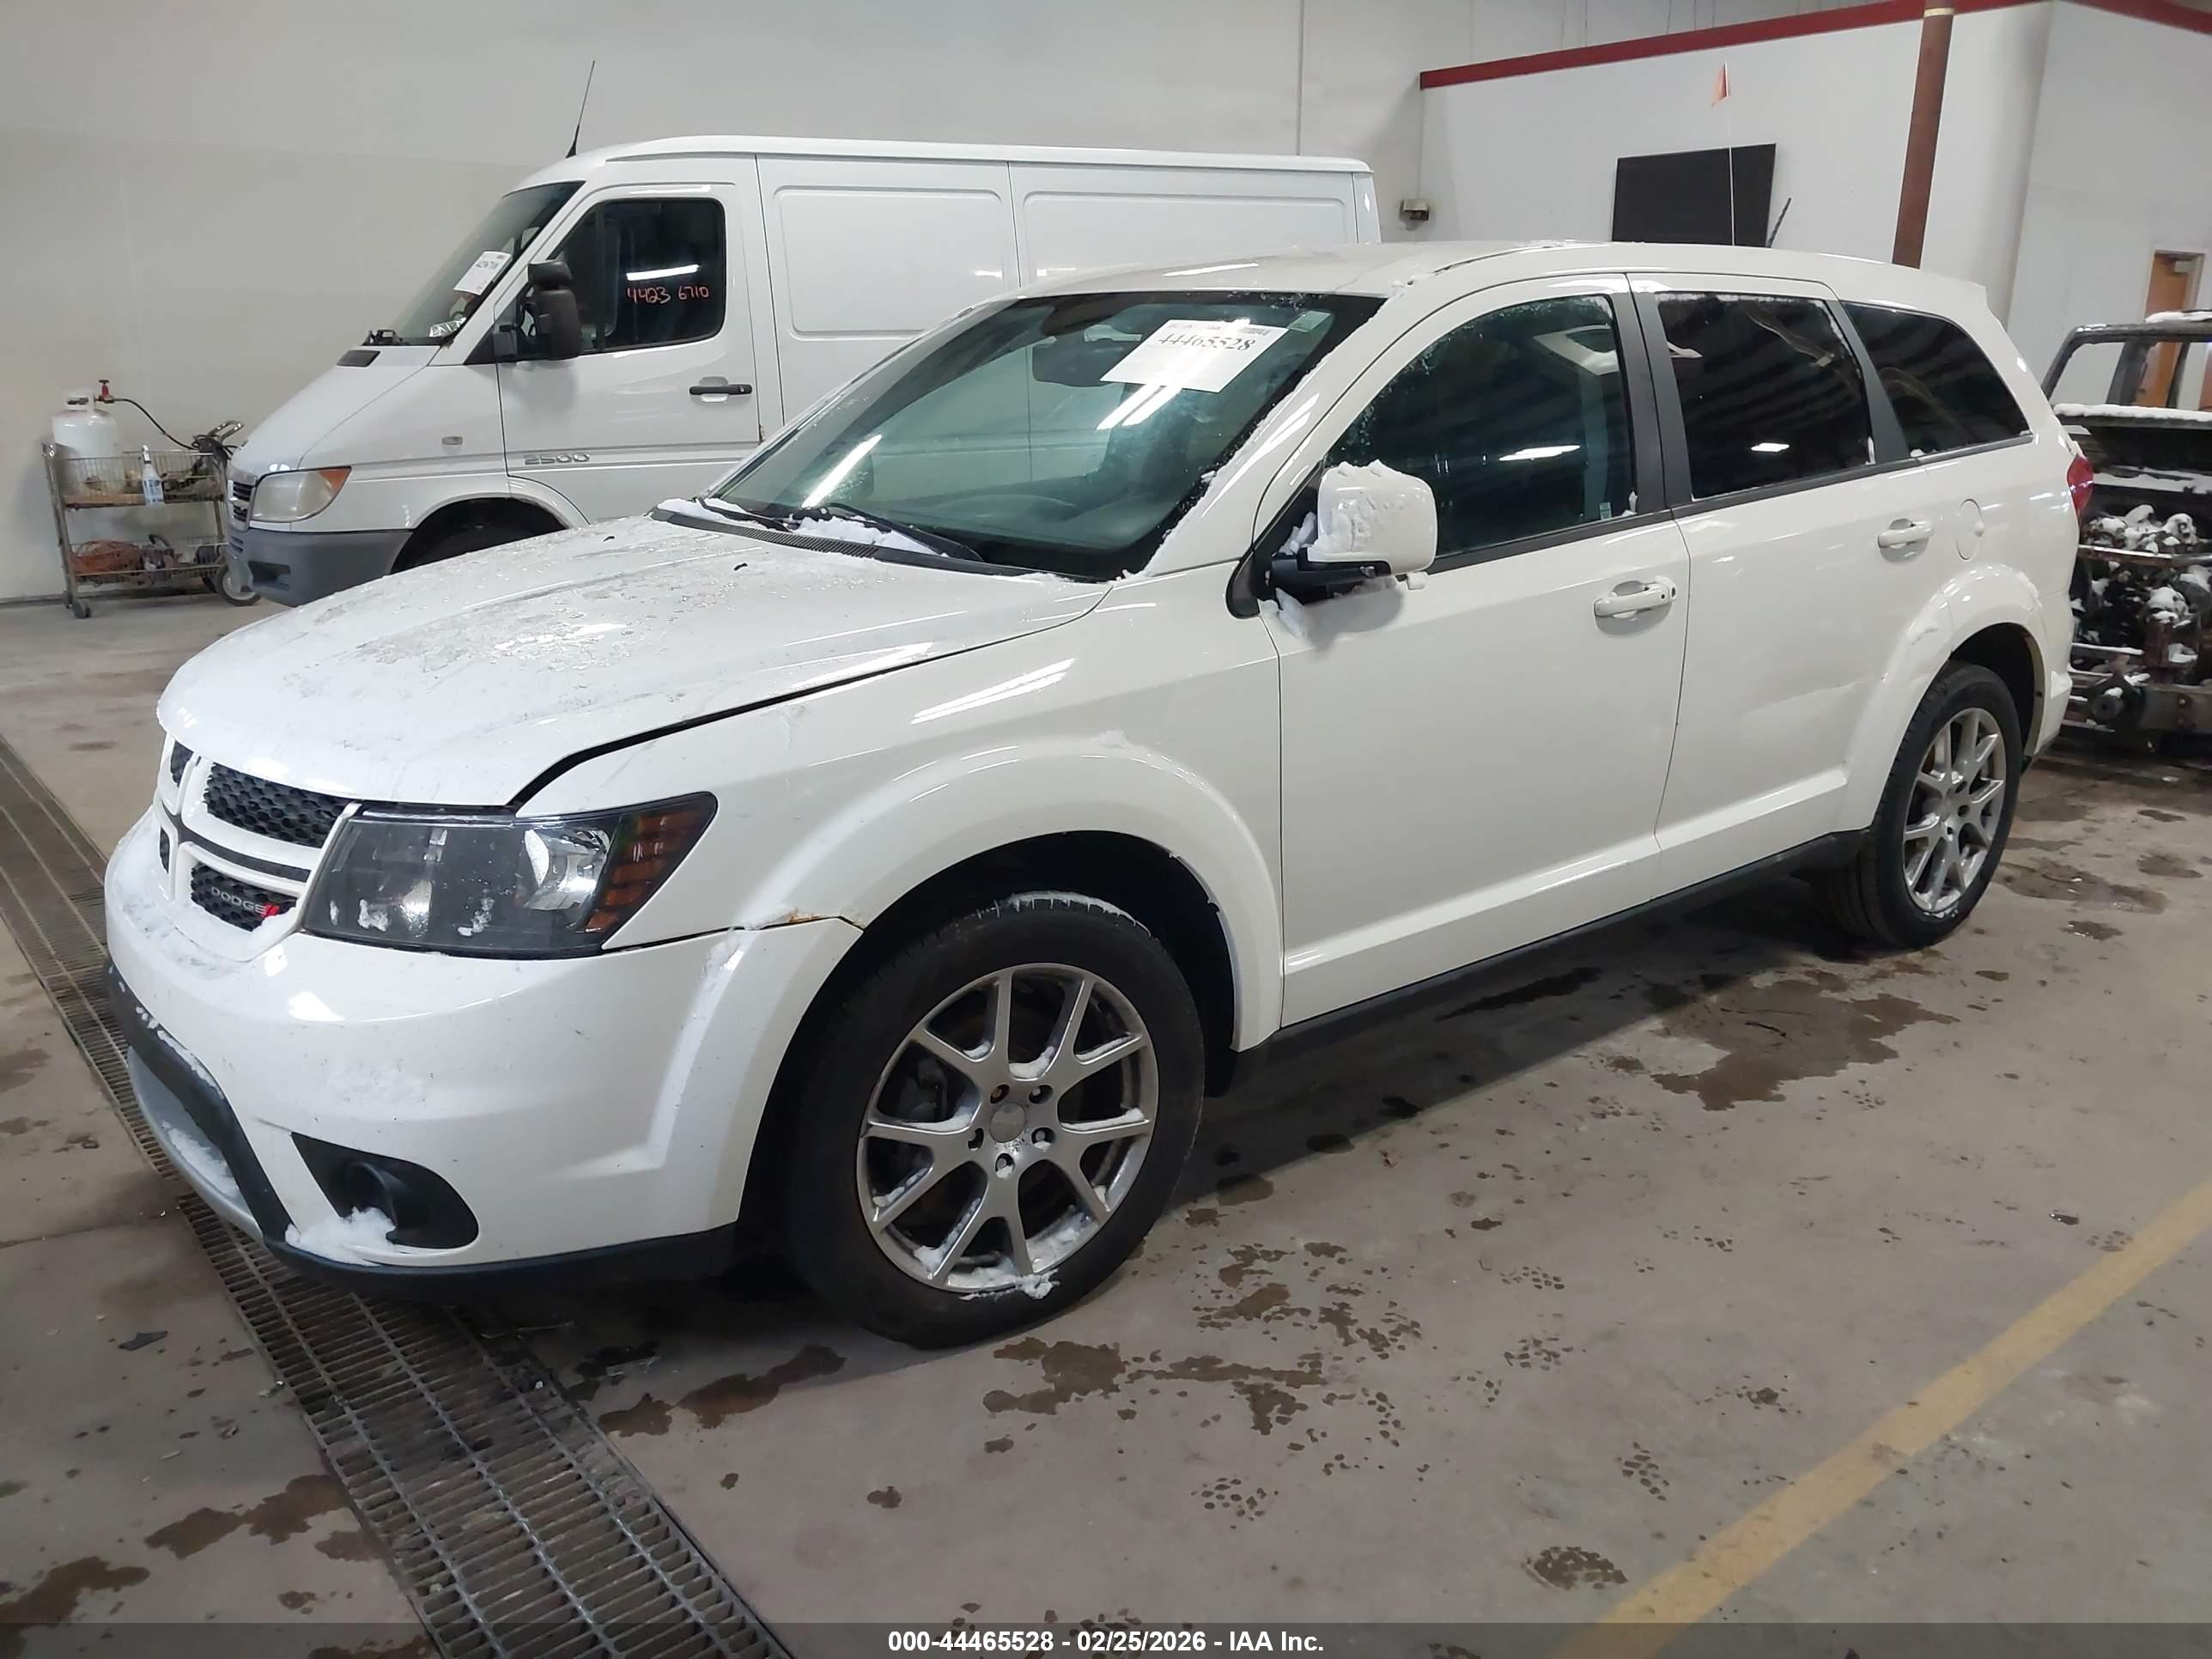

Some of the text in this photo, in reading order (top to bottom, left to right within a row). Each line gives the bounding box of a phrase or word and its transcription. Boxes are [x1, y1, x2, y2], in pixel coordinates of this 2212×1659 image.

[627, 285, 710, 304] 4423 6710
[523, 453, 591, 465] 2500
[210, 885, 268, 916] DODGE
